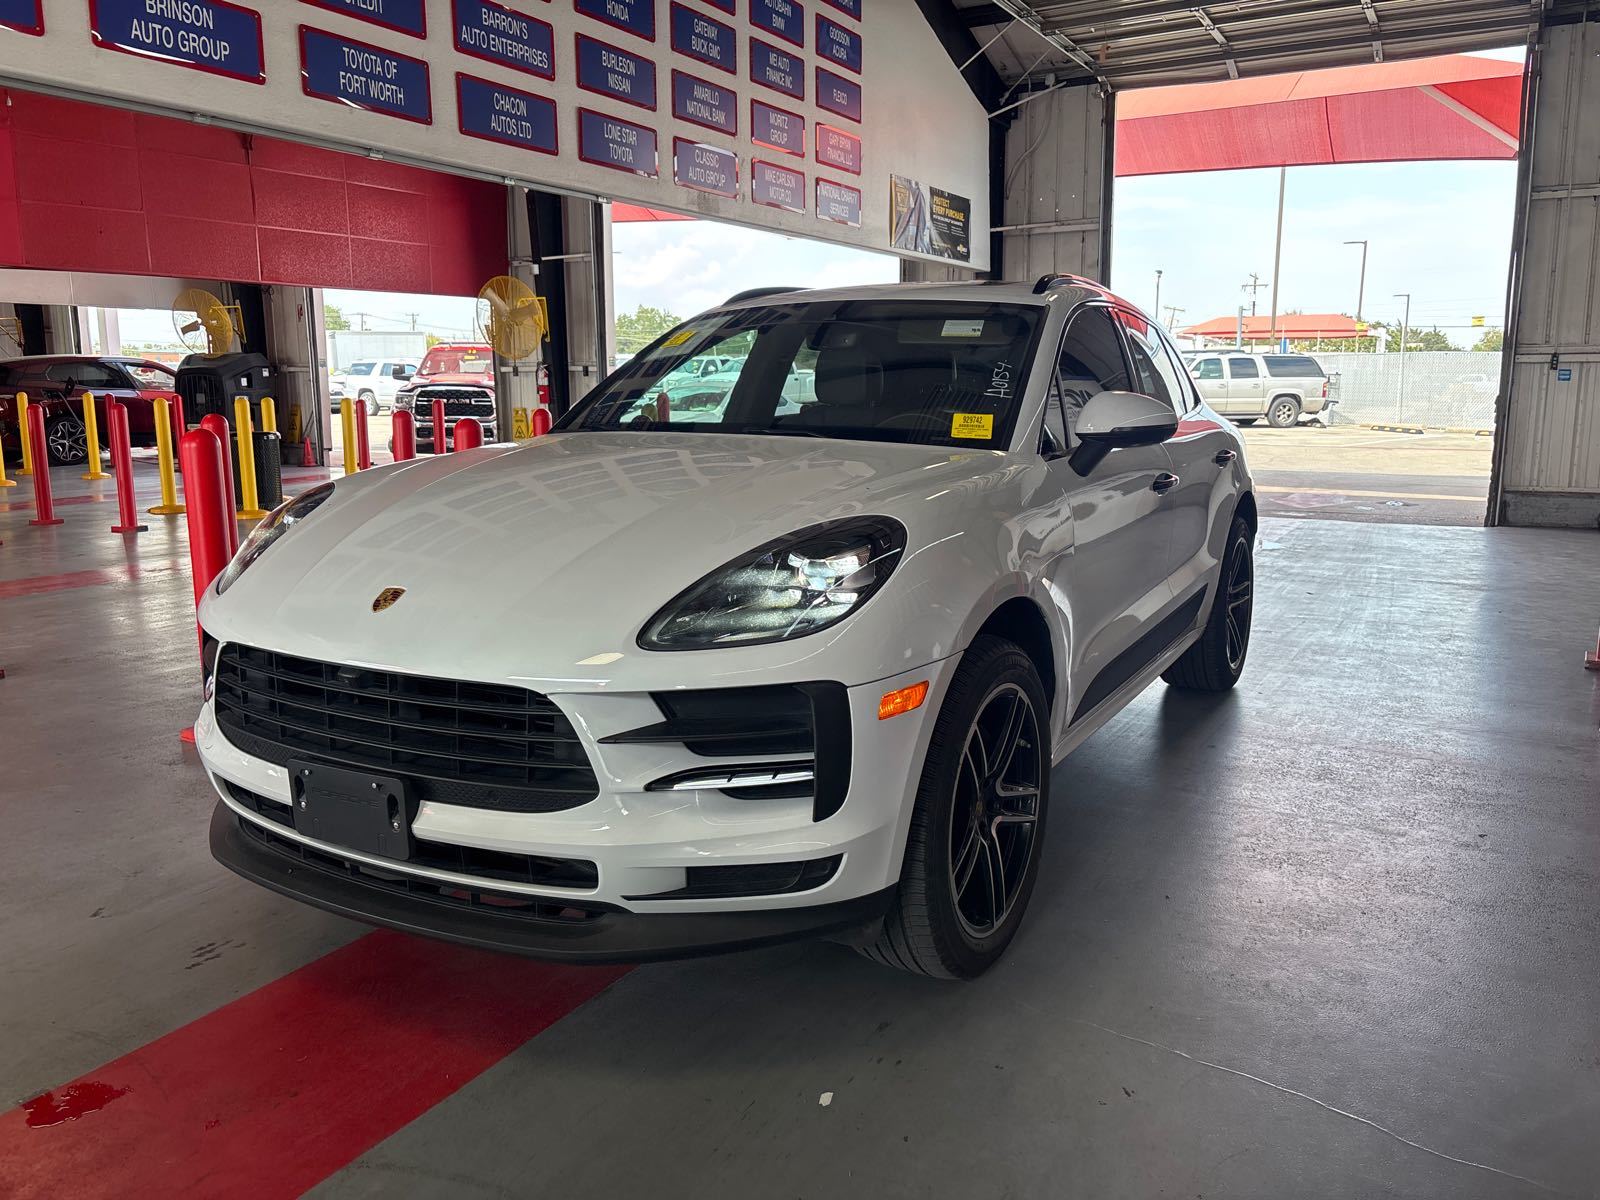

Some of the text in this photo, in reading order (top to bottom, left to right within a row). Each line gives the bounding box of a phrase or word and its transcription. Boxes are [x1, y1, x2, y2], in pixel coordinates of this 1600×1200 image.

[146, 0, 213, 29] BRINSON
[345, 0, 382, 14] DIT
[606, 0, 629, 22] HONDA
[482, 7, 528, 40] BARRON'S
[693, 18, 719, 41] GATEWAY
[772, 13, 785, 32] BMW
[131, 19, 230, 61] AUTO GROUP
[461, 25, 548, 69] AUTO ENTERPRISES
[691, 36, 721, 61] BUICK GMC
[342, 46, 397, 80] TOYOTA OF
[602, 50, 636, 77] BURLESON
[778, 55, 790, 72] AUTO
[832, 43, 848, 61] ACURA
[339, 71, 404, 106] FORT WORTH
[608, 73, 631, 94] NISSAN
[766, 66, 793, 89] FINANCE INC
[493, 91, 527, 118] CHACON
[693, 84, 720, 106] AMARILLO
[686, 100, 727, 126] NATIONAL BANK
[769, 111, 789, 130] MORITZ
[491, 114, 532, 139] AUTOS LTD
[604, 122, 638, 146] LONE STAR
[770, 129, 788, 145] GROUP
[609, 143, 634, 164] TOYOTA
[694, 149, 720, 168] CLASSIC
[688, 165, 726, 189] AUTO GROUP
[776, 171, 796, 189] CARLSON
